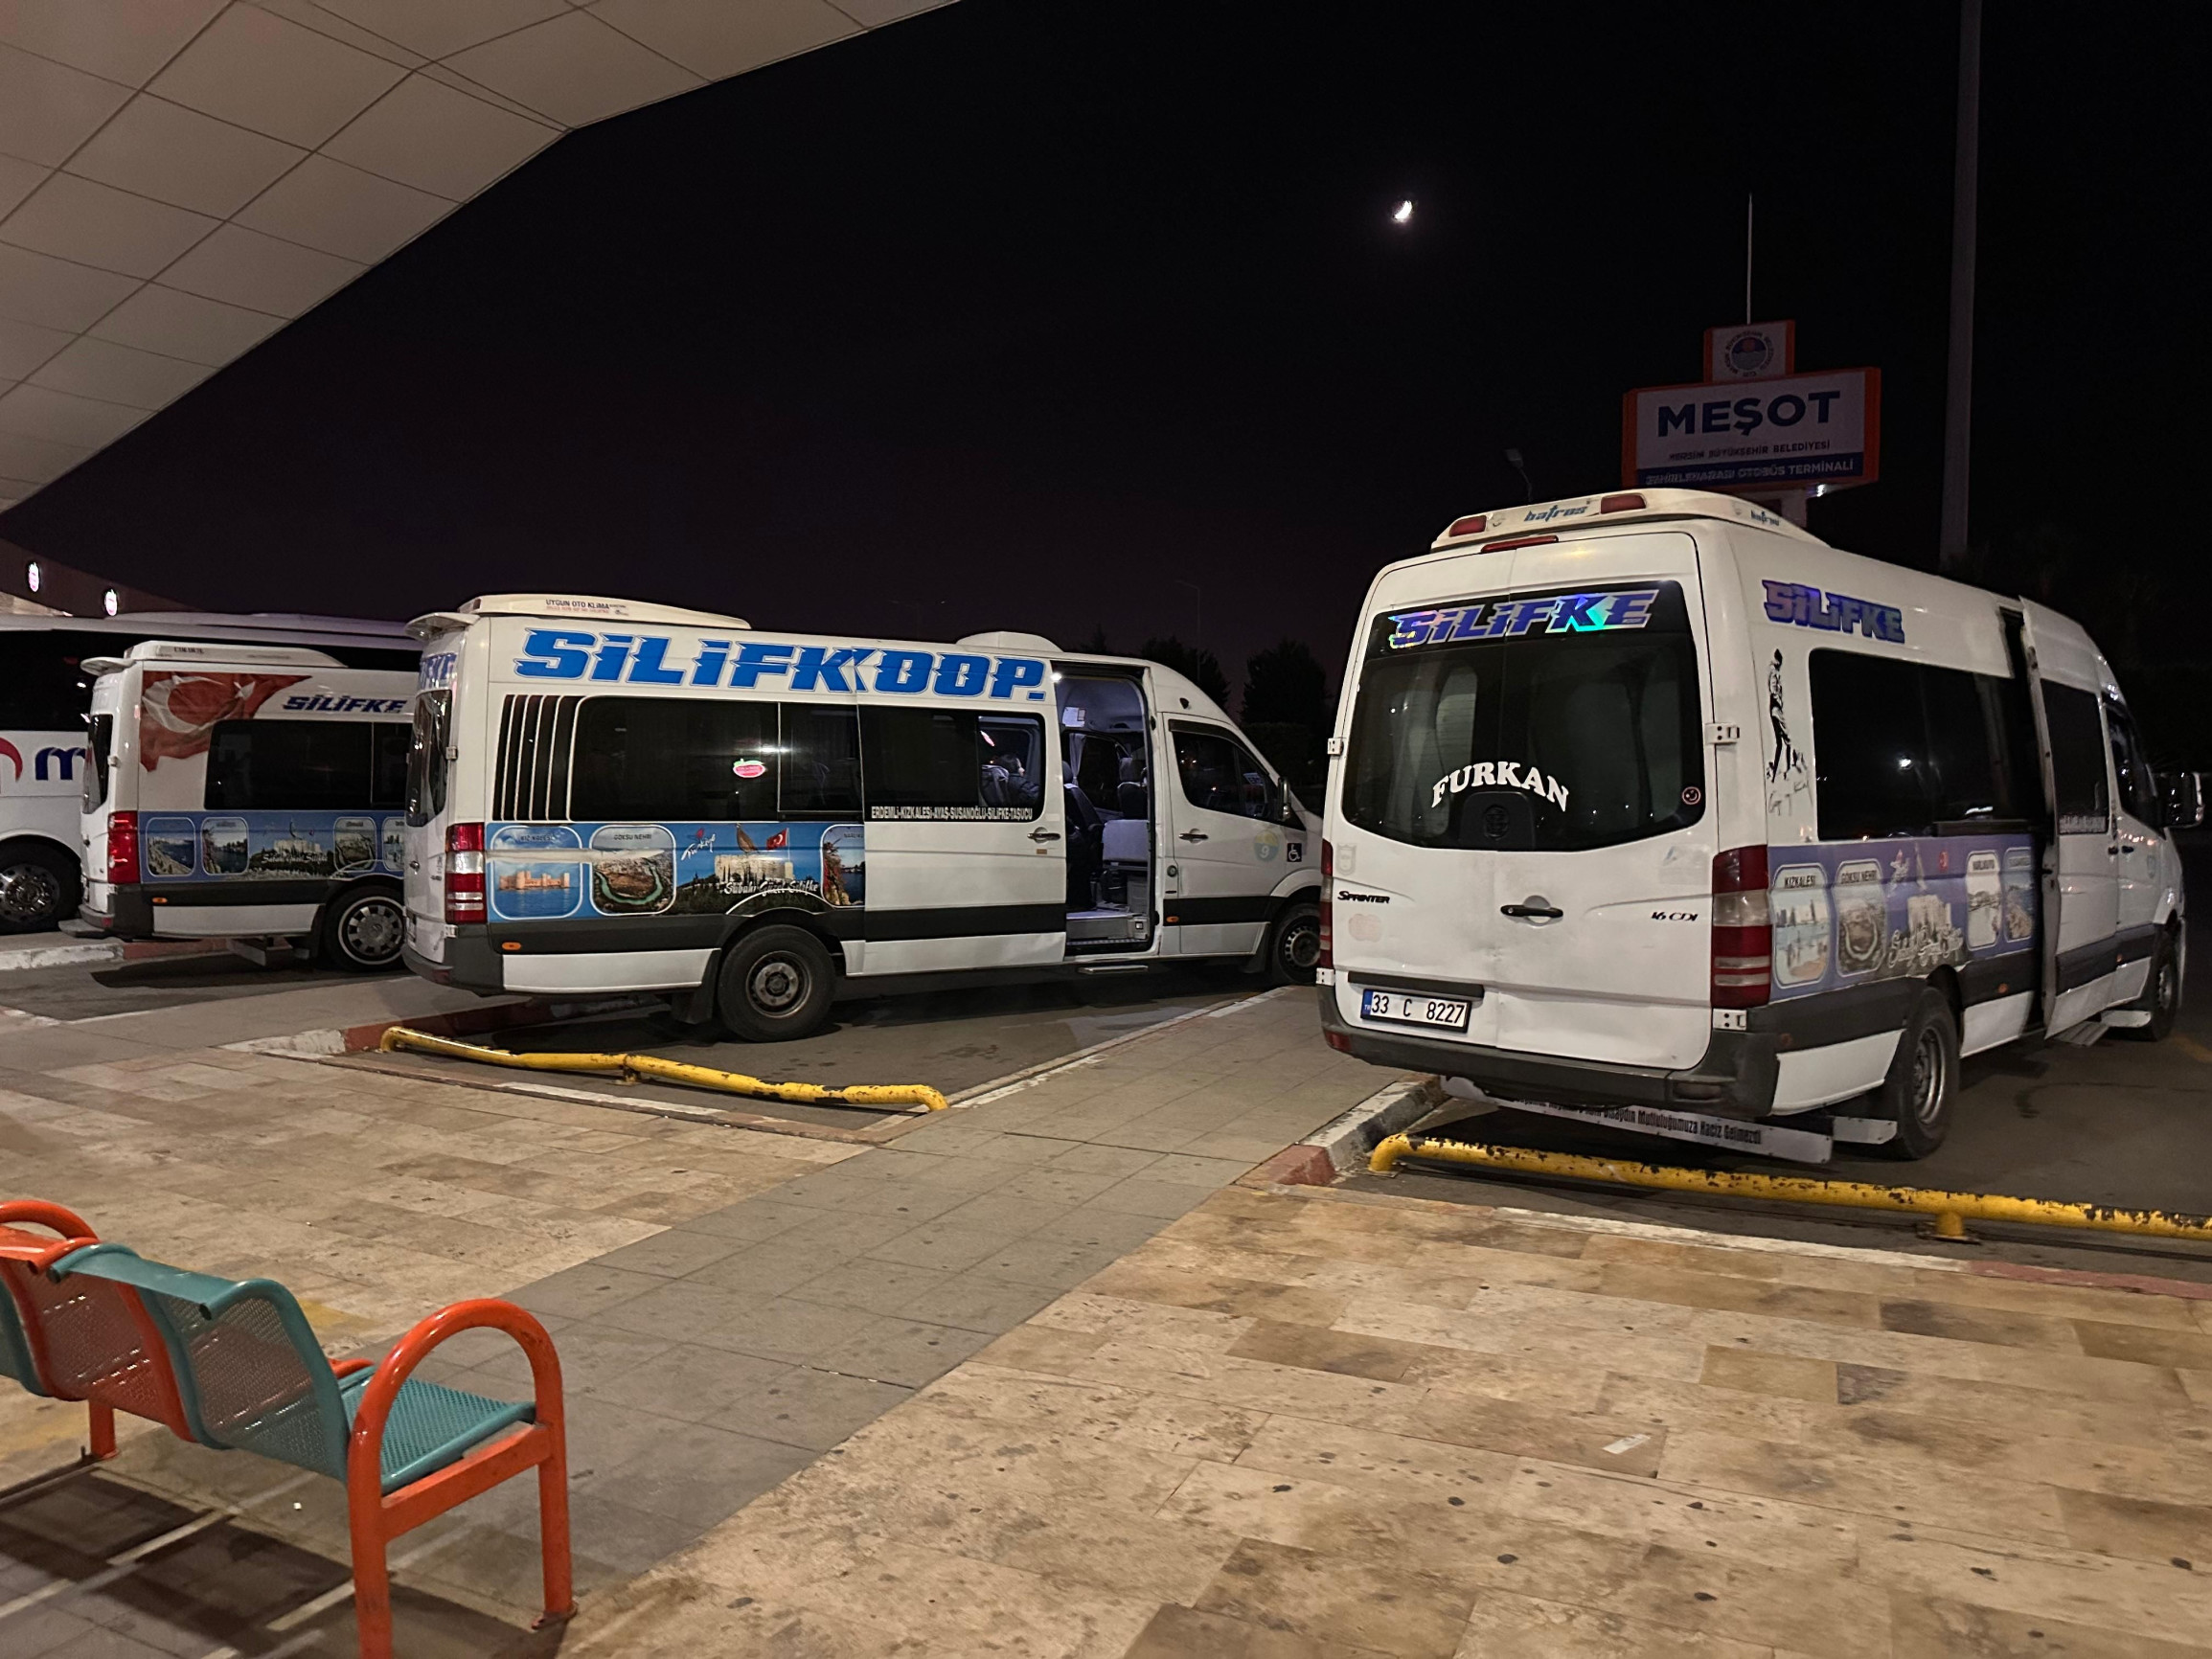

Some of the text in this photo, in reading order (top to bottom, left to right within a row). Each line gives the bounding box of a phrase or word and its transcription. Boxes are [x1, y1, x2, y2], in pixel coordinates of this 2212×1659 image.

[1658, 391, 1840, 437] MEŞOT
[1773, 440, 1830, 453] BELEDİYESİ
[1789, 459, 1855, 476] TERMİNALİ
[1431, 761, 1569, 812] FURKAN
[1669, 912, 1699, 921] CDI
[1372, 994, 1466, 1024] 33 C 8227
